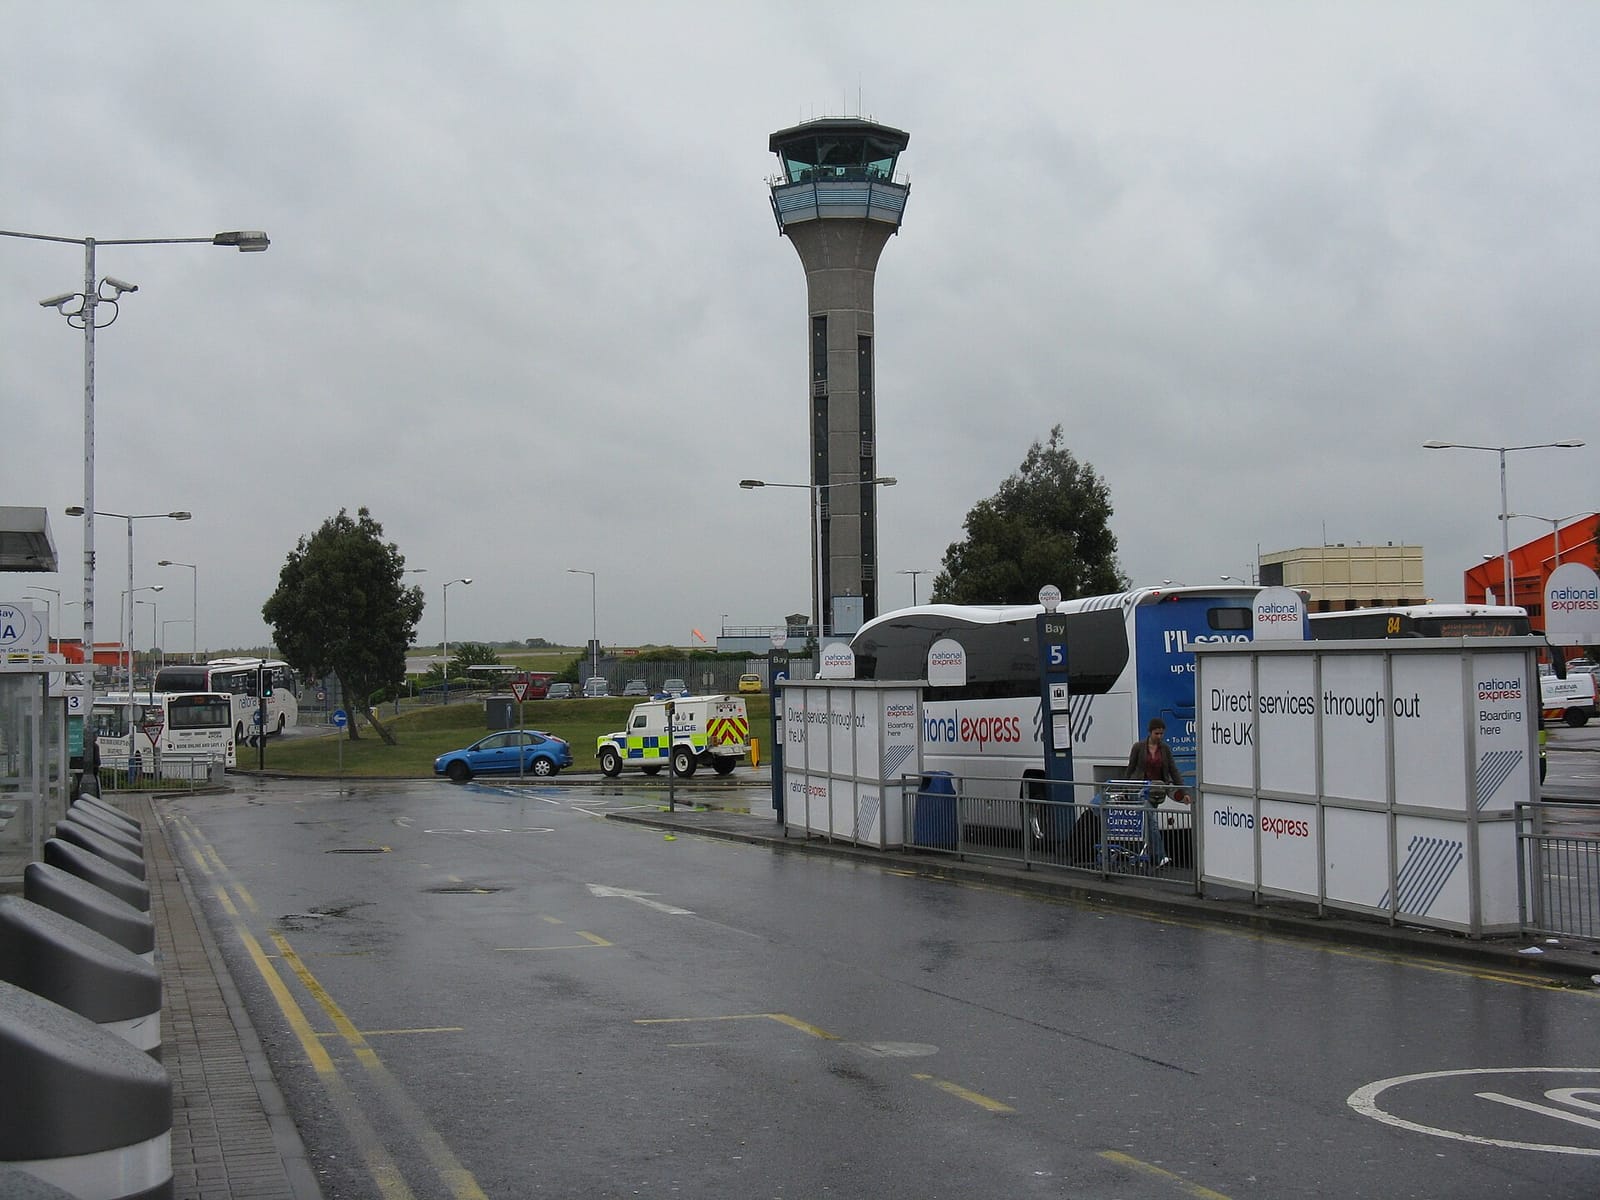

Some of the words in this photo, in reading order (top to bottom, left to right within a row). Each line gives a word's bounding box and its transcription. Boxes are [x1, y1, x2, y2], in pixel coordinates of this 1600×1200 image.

[1550, 586, 1598, 600] national
[1257, 602, 1297, 614] national
[1551, 600, 1599, 613] express
[0, 611, 14, 619] ay
[1258, 614, 1298, 624] express
[1045, 623, 1065, 635] Bay
[1387, 616, 1401, 634] 84
[772, 655, 787, 665] Bay
[824, 653, 852, 661] national
[931, 651, 962, 659] national
[1050, 645, 1063, 665] 5
[931, 658, 962, 666] express
[1170, 664, 1185, 675] up
[1477, 678, 1521, 691] national
[69, 696, 80, 708] 3
[1478, 690, 1522, 703] express
[886, 703, 914, 712] national
[1211, 688, 1252, 713] Direct
[1259, 690, 1315, 715] services
[1323, 691, 1385, 724] through
[1393, 693, 1421, 718] out
[886, 710, 914, 718] express
[1479, 709, 1522, 722] Boarding
[663, 724, 697, 732] POLICE
[887, 721, 914, 730] Boarding
[1480, 725, 1501, 735] here
[960, 716, 1021, 752] express
[1211, 721, 1231, 744] the
[1233, 722, 1253, 745] UK
[1261, 816, 1309, 839] express
